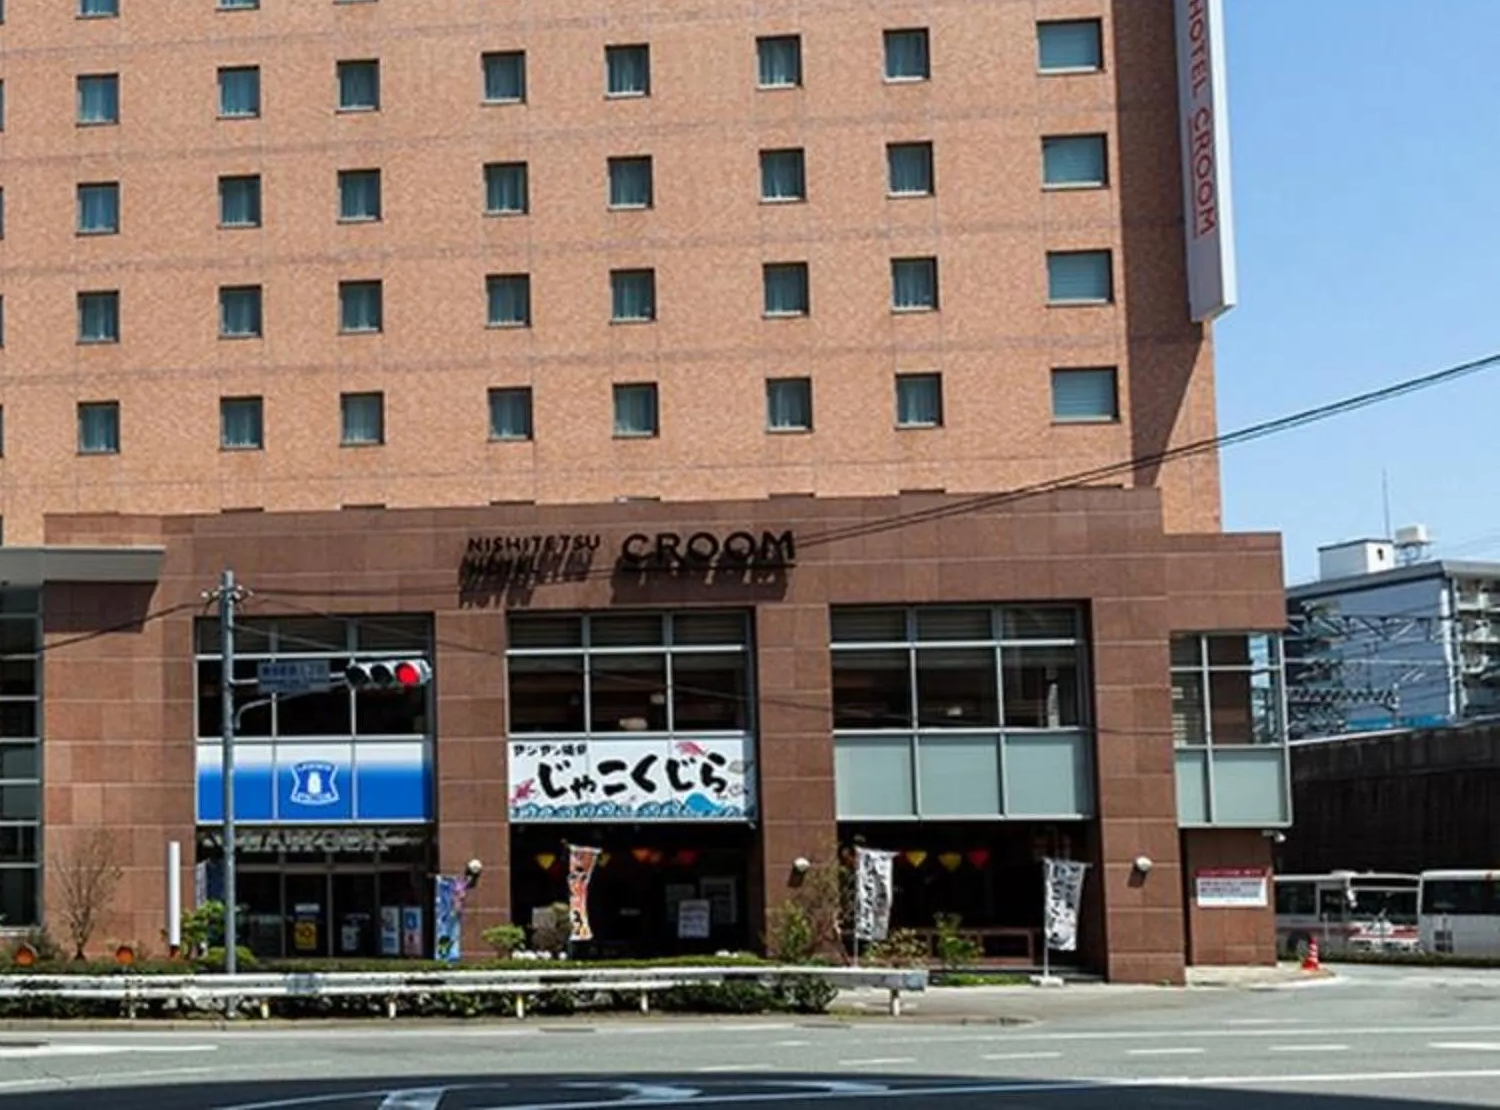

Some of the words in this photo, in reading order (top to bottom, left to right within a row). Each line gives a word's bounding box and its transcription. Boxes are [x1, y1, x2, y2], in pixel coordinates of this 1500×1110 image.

[1188, 0, 1210, 98] HOTEL
[1192, 107, 1216, 236] CROOM
[468, 534, 599, 554] NISHITETSU
[621, 530, 796, 564] CROOM
[538, 753, 727, 799] じゃこくじら
